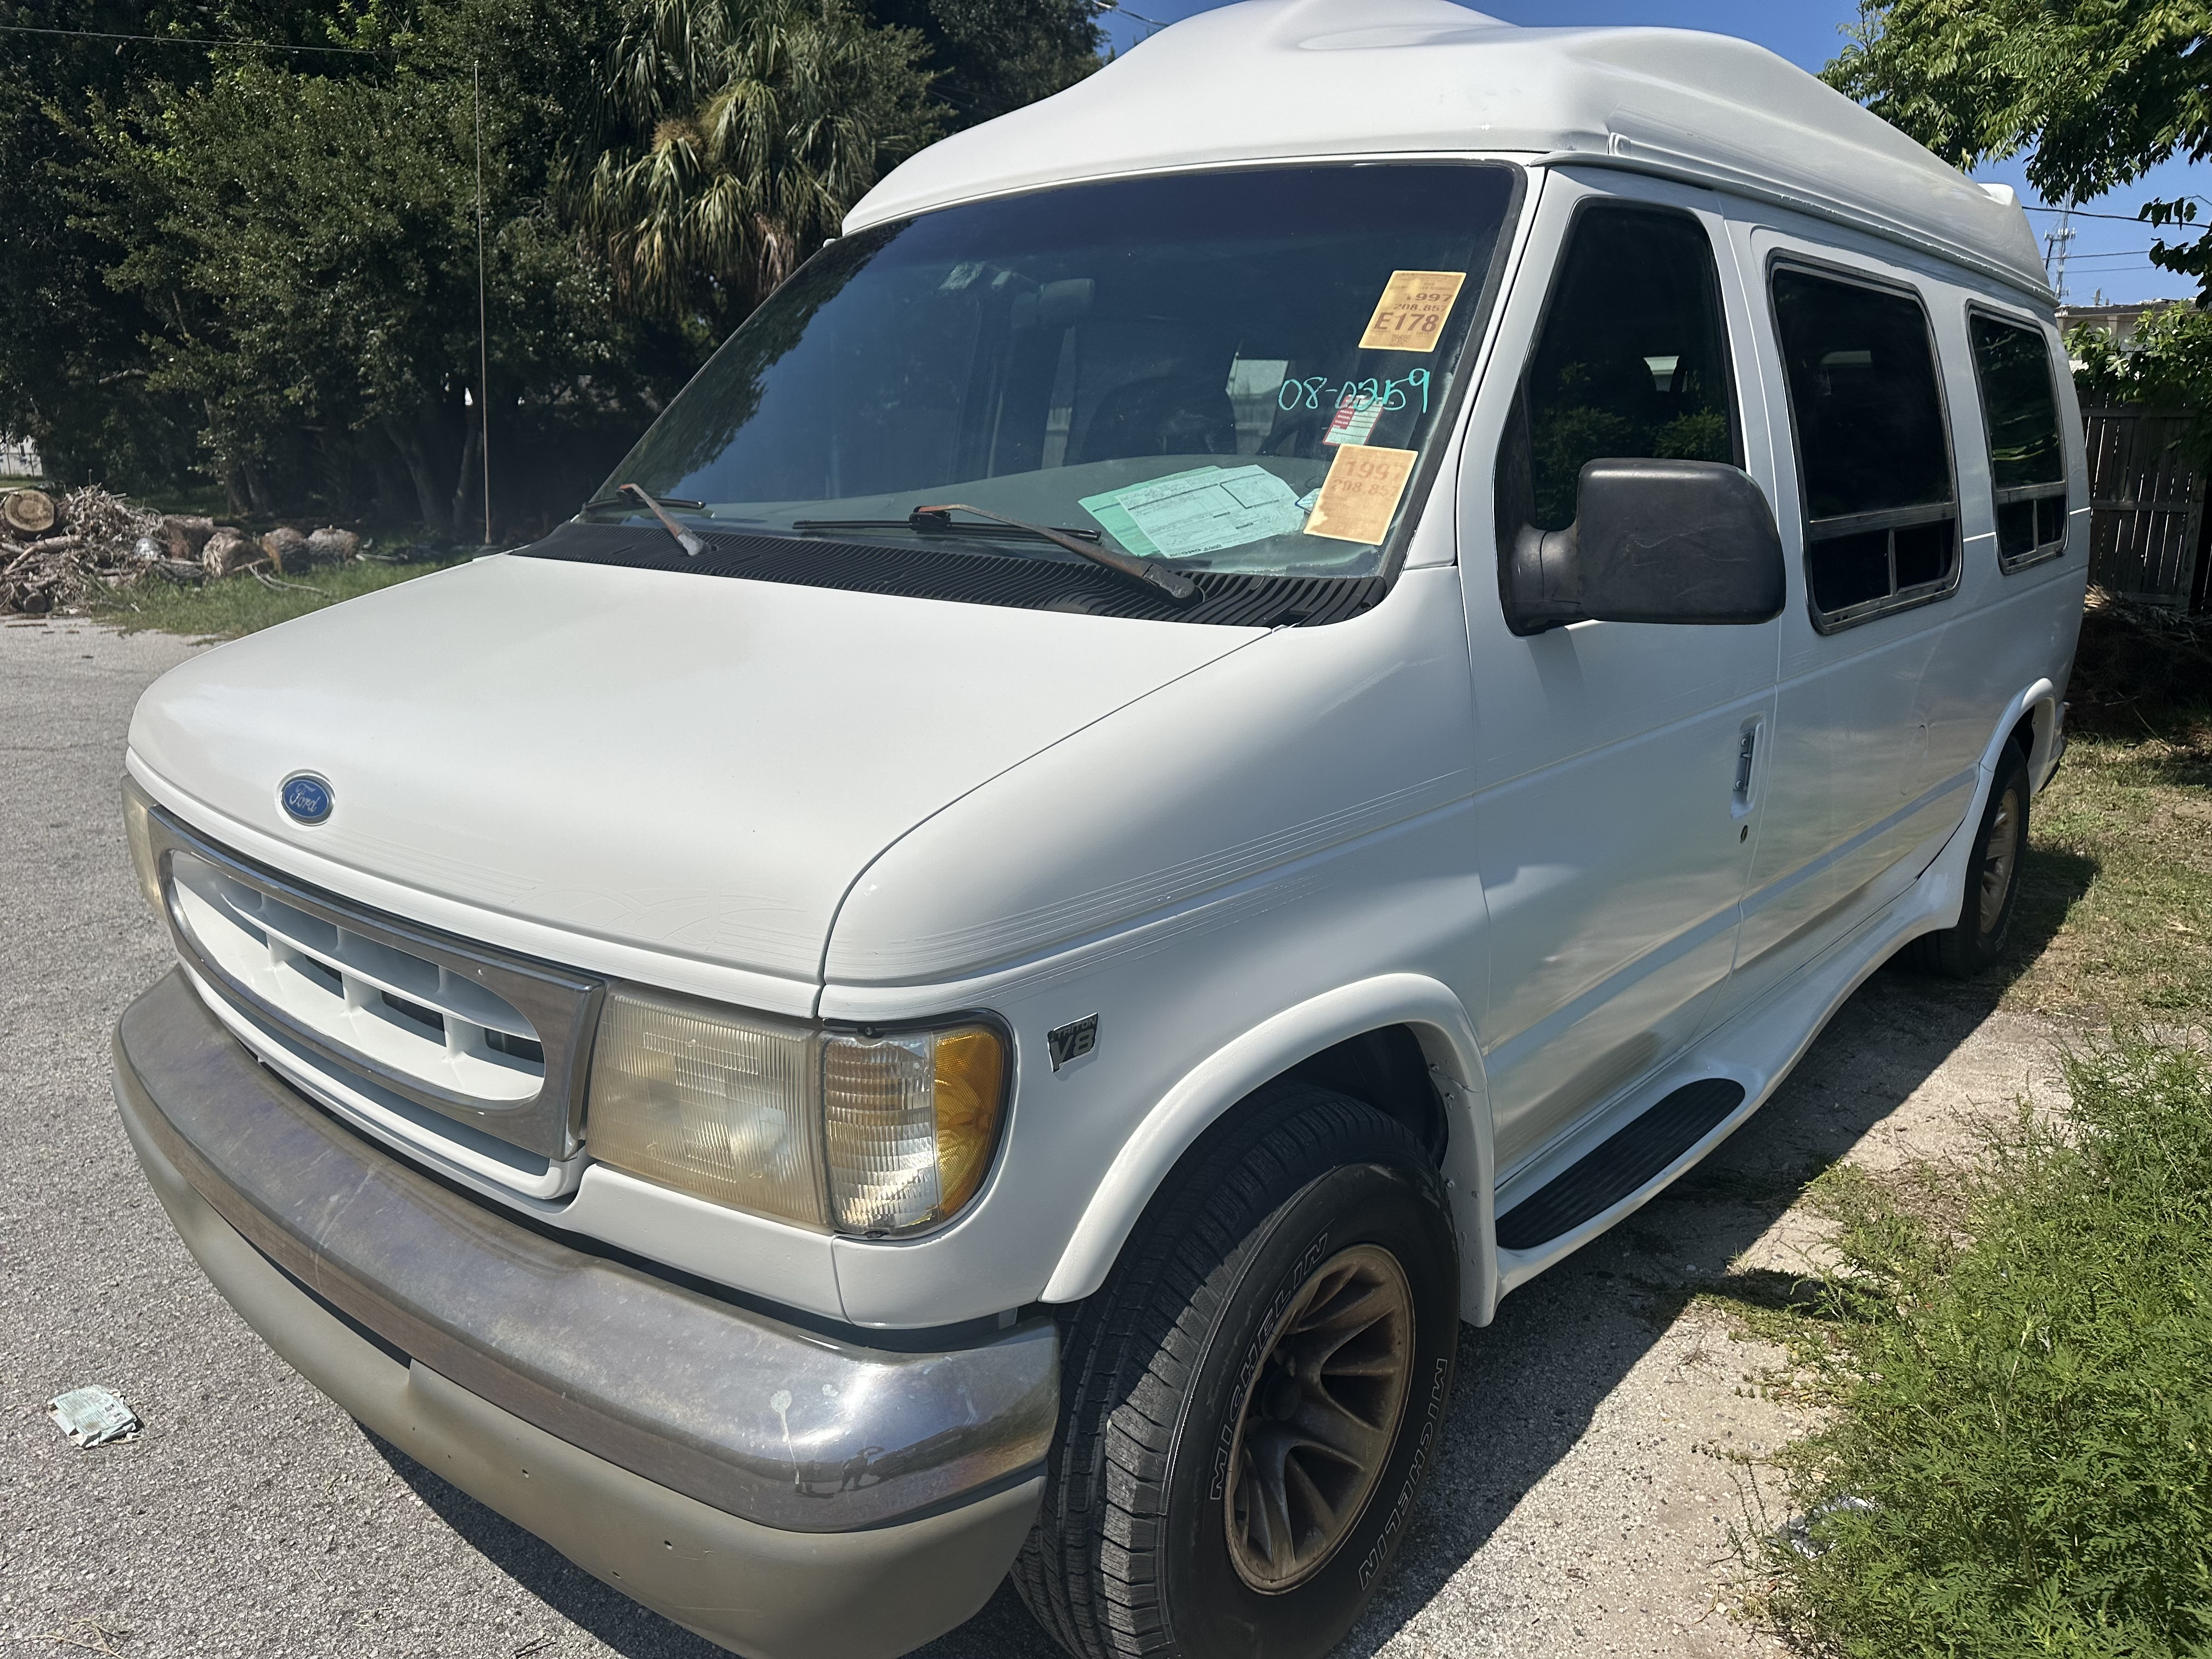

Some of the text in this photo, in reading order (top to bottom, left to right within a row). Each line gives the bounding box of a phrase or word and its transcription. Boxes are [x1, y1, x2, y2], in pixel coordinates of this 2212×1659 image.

[1374, 312, 1440, 332] E178
[1393, 303, 1448, 312] 208.857
[289, 783, 321, 813] Ford
[1056, 1016, 1097, 1039] TRITON
[1050, 1029, 1094, 1070] V8
[1210, 1232, 1328, 1500] MICHELIN
[1358, 1358, 1447, 1590] MICHELIN
